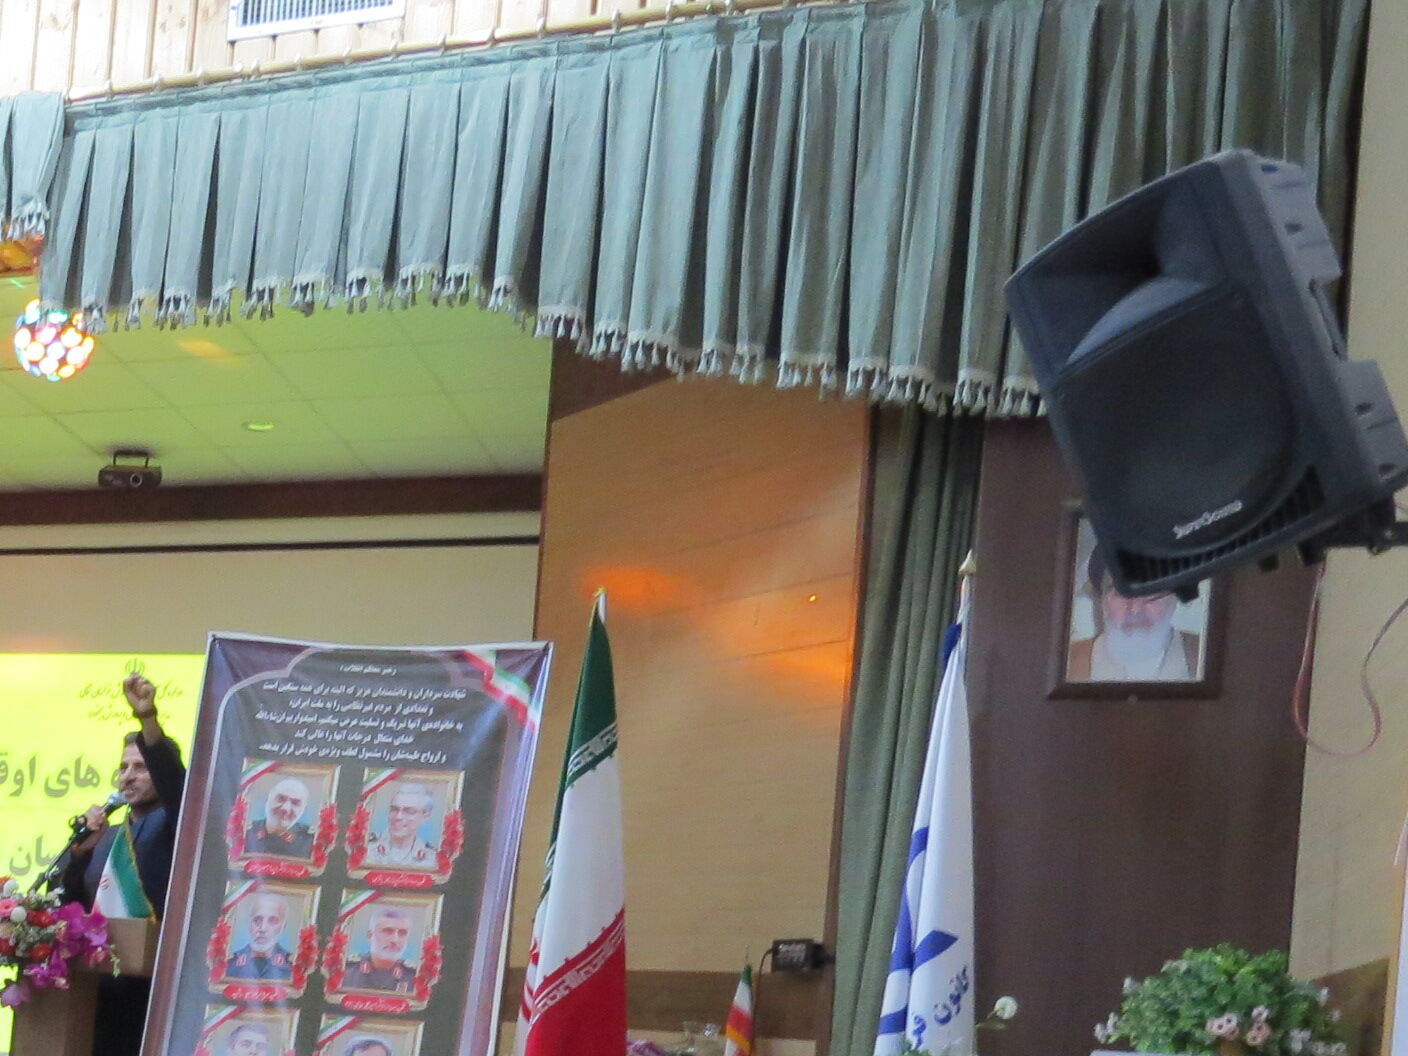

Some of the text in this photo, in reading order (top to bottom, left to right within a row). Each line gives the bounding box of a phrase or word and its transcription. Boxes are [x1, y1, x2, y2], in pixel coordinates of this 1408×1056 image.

[313, 682, 330, 695] برای
[372, 687, 407, 698] دانشمندان
[413, 687, 443, 700] سرداران
[443, 688, 467, 700] شهادت
[374, 703, 392, 714] مردم
[393, 733, 414, 746] خدای
[44, 755, 101, 798] های
